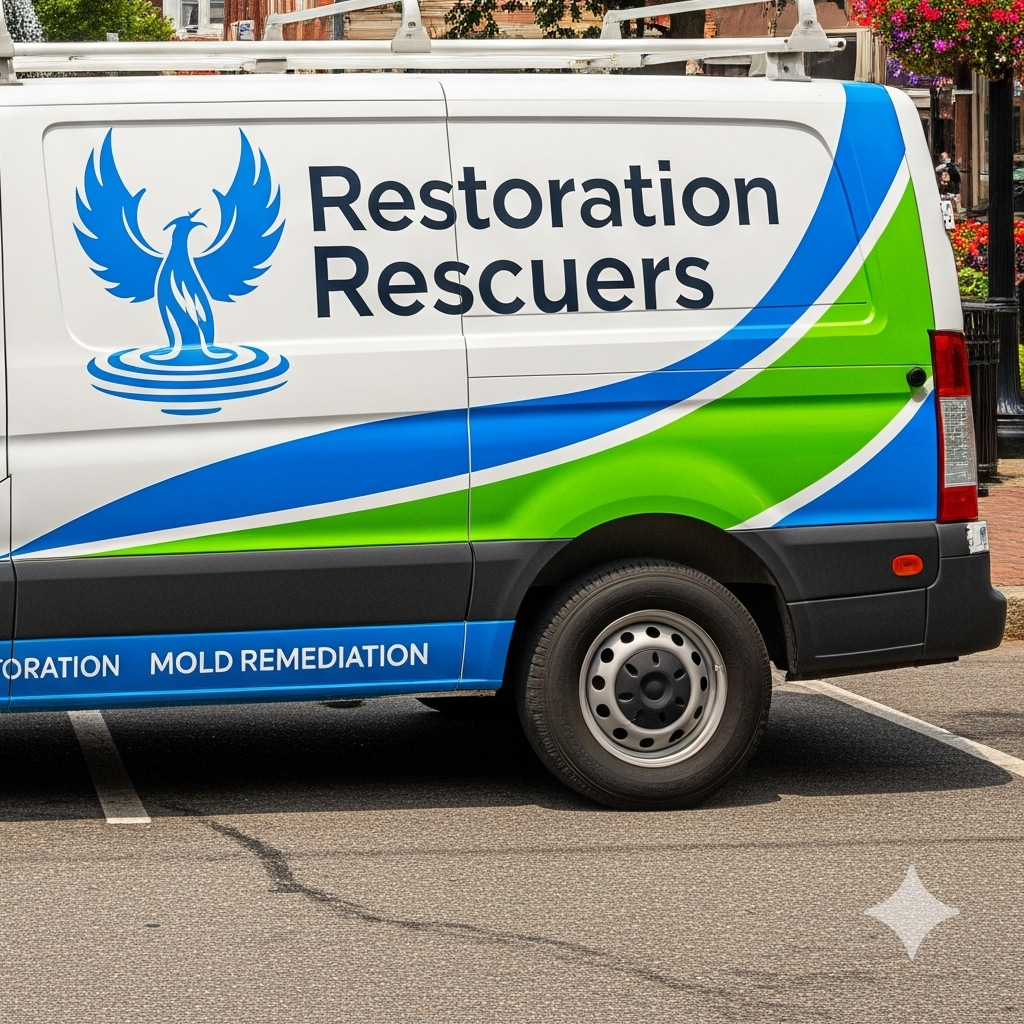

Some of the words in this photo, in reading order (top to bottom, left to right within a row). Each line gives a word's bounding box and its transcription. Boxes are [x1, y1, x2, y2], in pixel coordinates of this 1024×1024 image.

[308, 160, 780, 232] Restoration
[313, 245, 714, 318] Rescuers
[150, 650, 233, 675] MOLD
[241, 642, 428, 672] REMEDIATION
